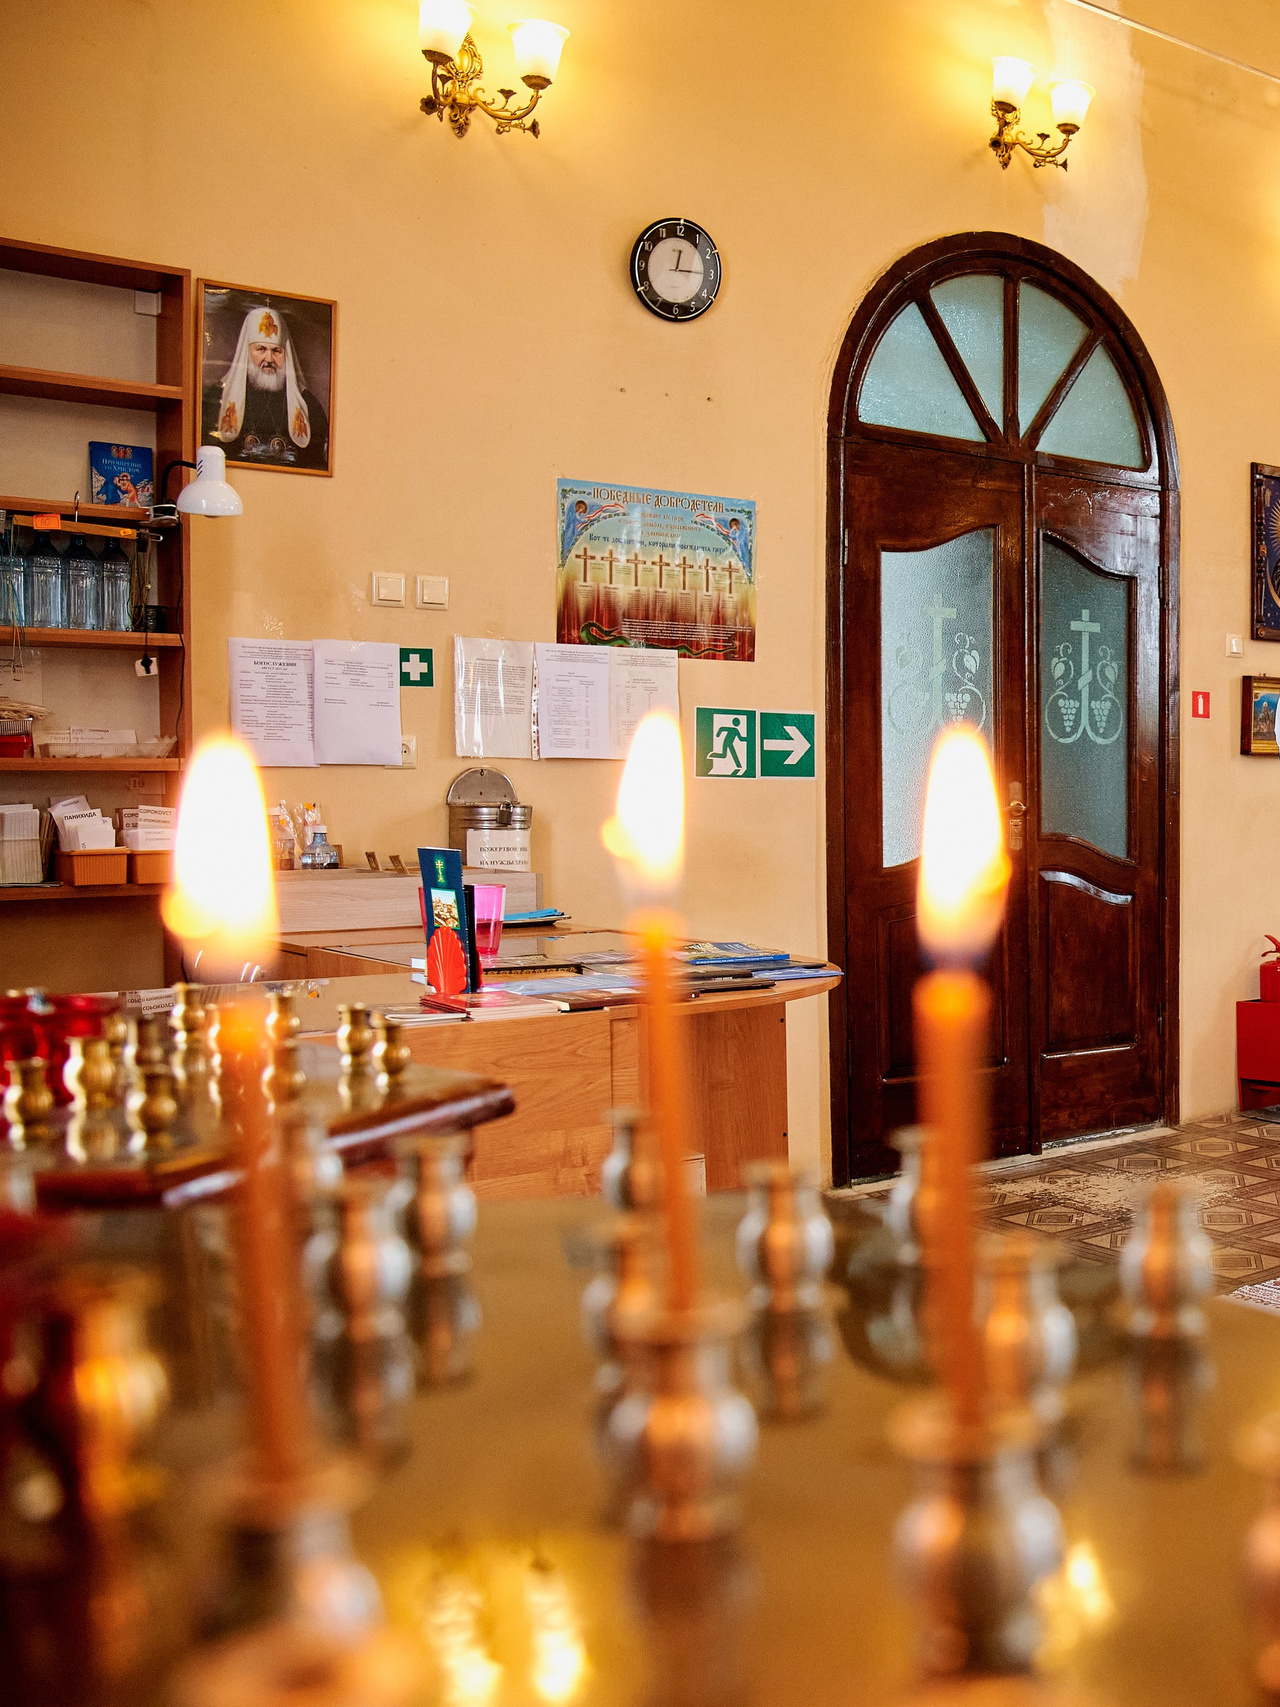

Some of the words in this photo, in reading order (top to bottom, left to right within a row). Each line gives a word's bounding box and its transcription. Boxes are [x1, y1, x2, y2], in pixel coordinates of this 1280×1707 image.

[659, 228, 667, 238] 11
[676, 225, 685, 237] 12
[696, 233, 700, 244] 1
[644, 240, 653, 252] 10
[705, 248, 711, 260] 2
[639, 261, 646, 271] 9
[709, 269, 715, 280] 3
[643, 280, 649, 291] 8
[701, 288, 707, 299] 4
[656, 297, 662, 307] 7
[690, 301, 696, 312] 5
[672, 304, 679, 315] 6
[592, 487, 652, 505] ПОБЕДНЫЕ
[654, 494, 724, 514] ДОБРОДЕТЕЛИ
[64, 811, 97, 821] ПАНИХИДА
[139, 808, 172, 816] СОРОКОУСТ
